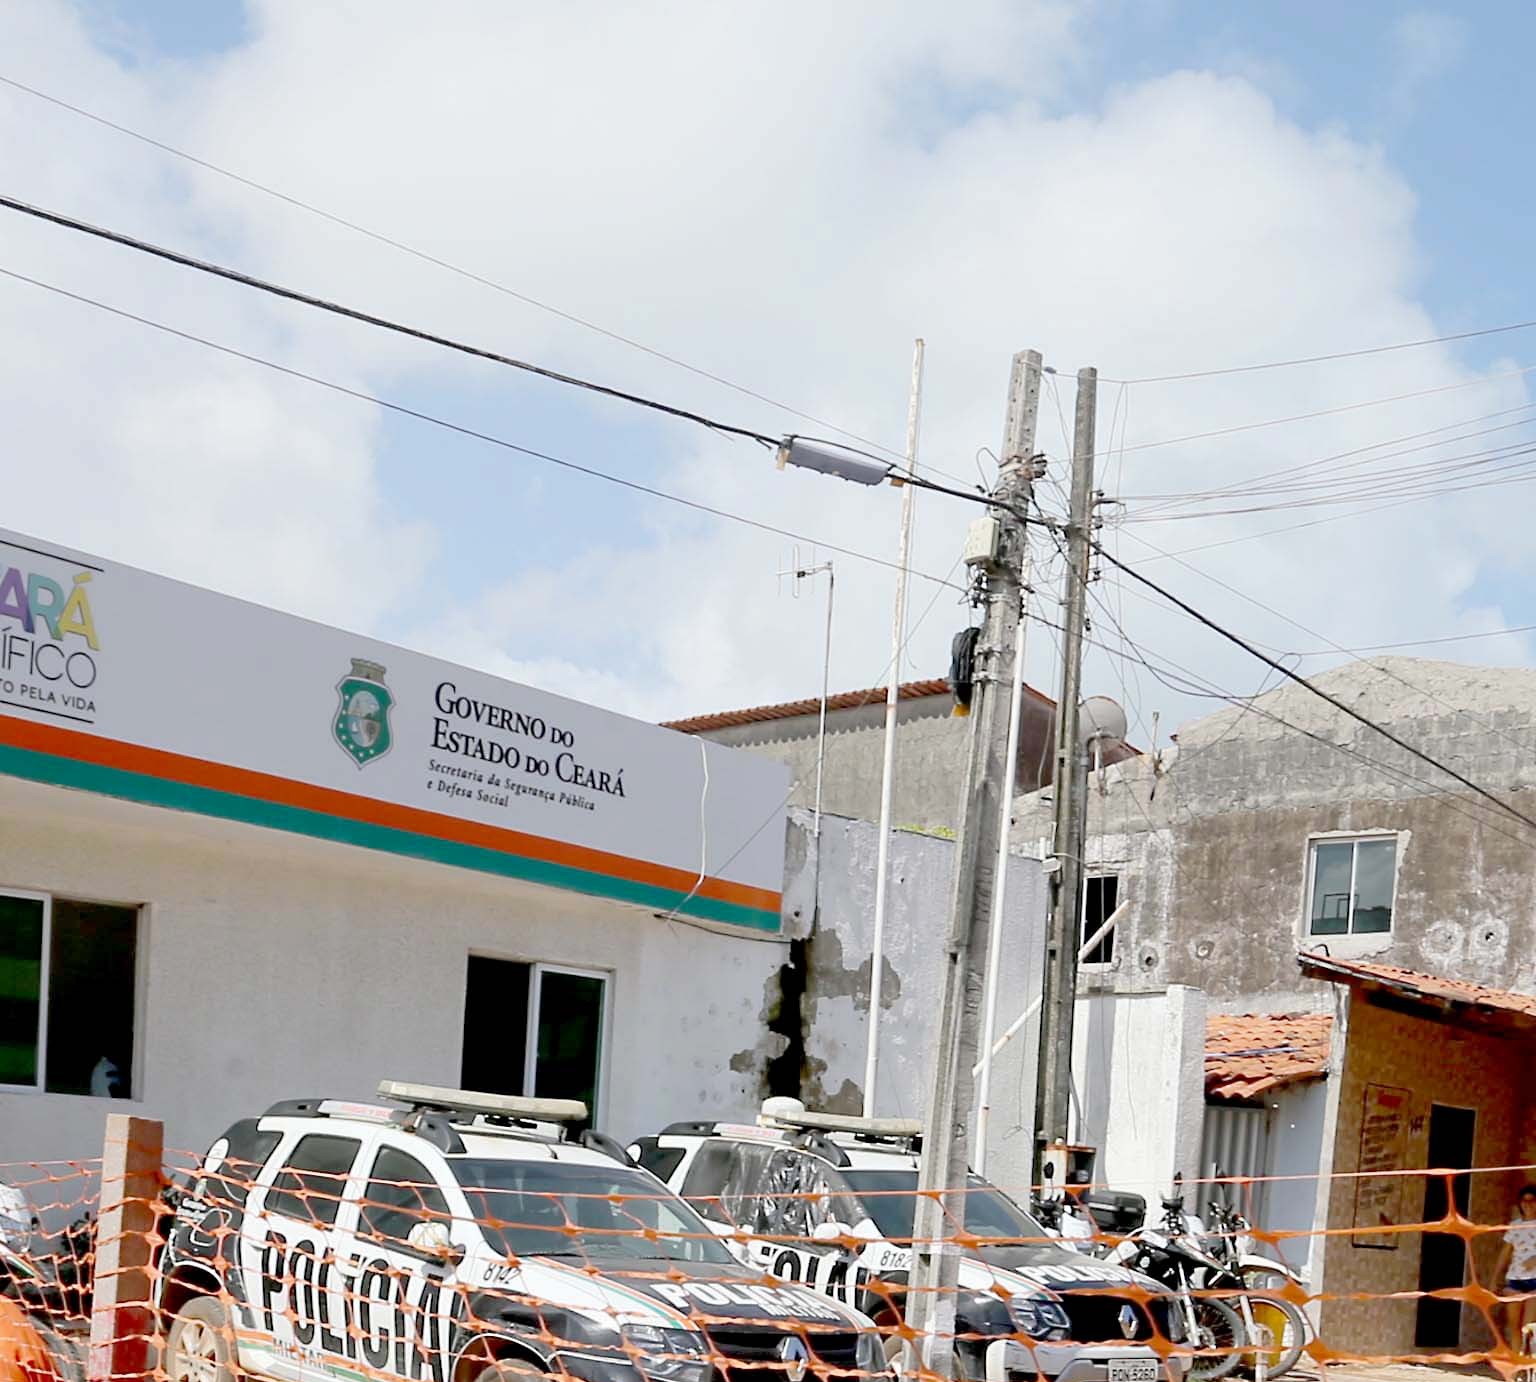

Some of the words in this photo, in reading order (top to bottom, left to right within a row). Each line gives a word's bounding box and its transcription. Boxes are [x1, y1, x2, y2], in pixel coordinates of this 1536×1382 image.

[20, 684, 62, 705] PELA
[62, 694, 97, 713] VIDA
[550, 726, 575, 749] DO
[525, 755, 550, 777] DO
[426, 779, 433, 790] e
[437, 780, 473, 799] Defesa
[477, 788, 510, 808] Social
[427, 758, 485, 785] Secretaria
[488, 773, 502, 789] da
[504, 777, 556, 803] Segurança
[559, 791, 596, 812] Pública
